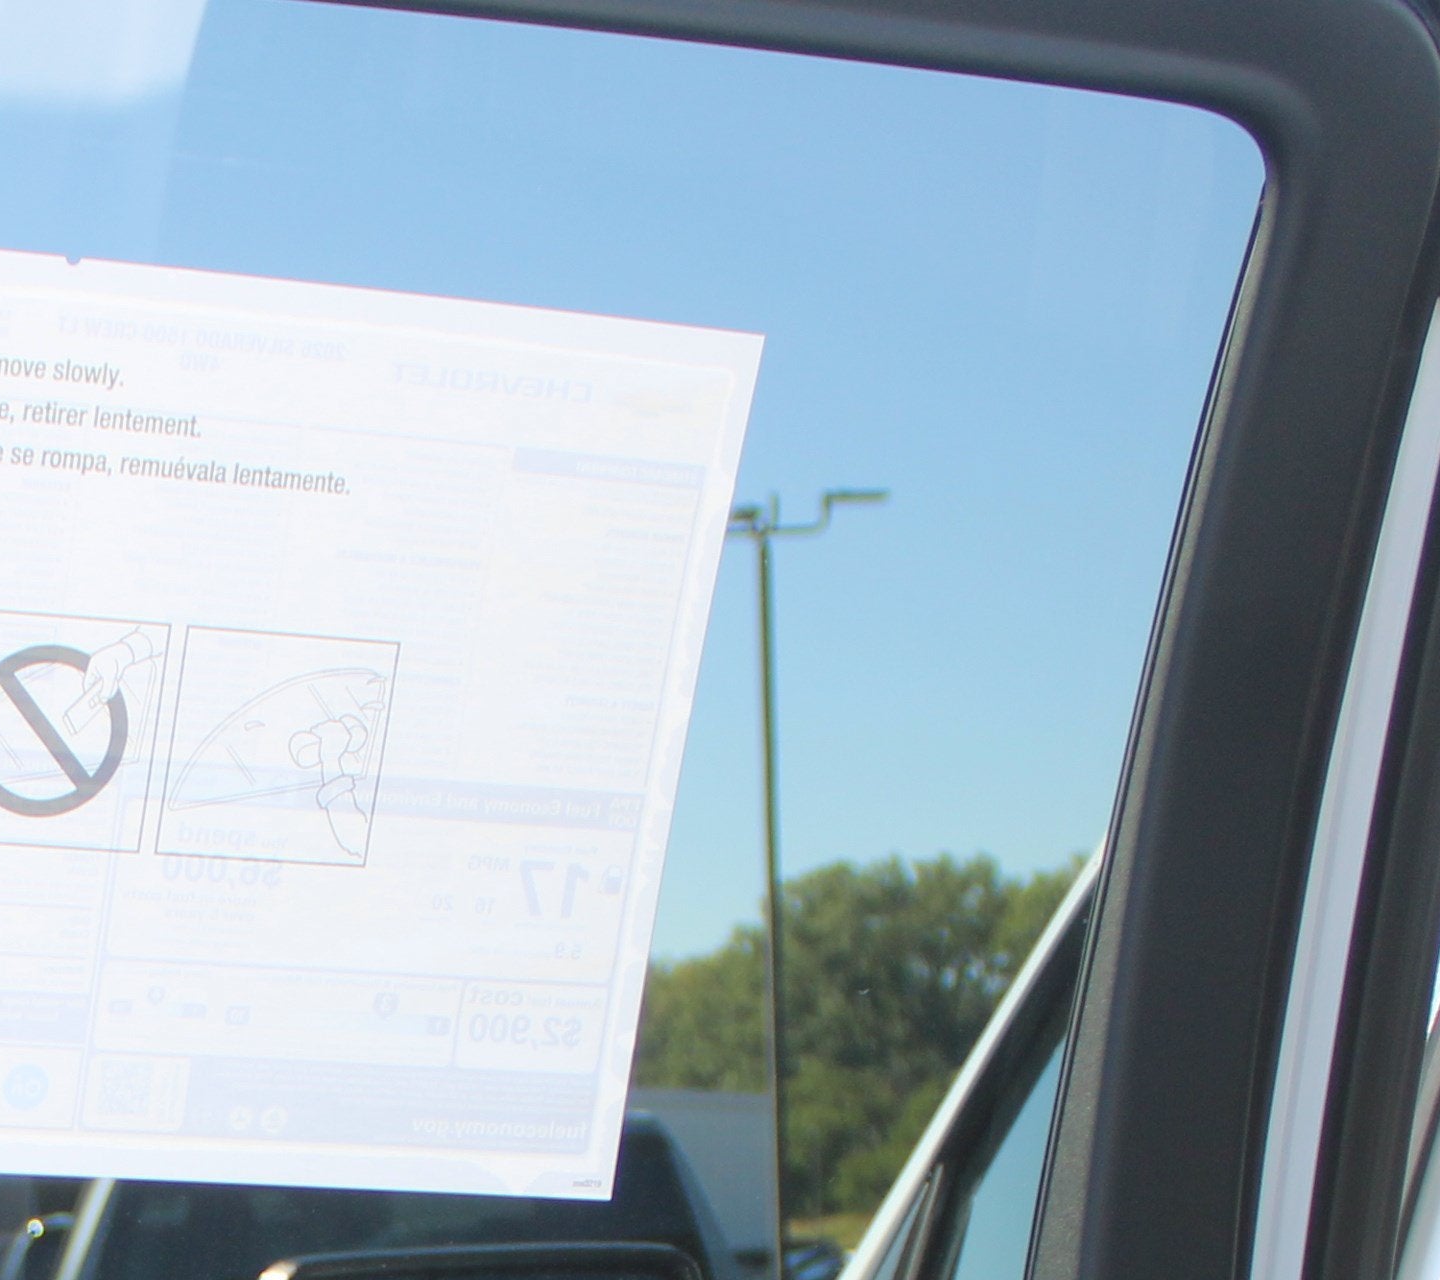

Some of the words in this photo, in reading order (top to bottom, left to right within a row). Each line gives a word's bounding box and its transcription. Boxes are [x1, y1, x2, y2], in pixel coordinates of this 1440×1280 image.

[53, 359, 125, 390] slowly.
[23, 401, 88, 427] retirer
[94, 405, 202, 438] lentement.
[11, 447, 34, 466] se
[41, 449, 112, 476] rompa,
[120, 455, 227, 483] remuévala
[233, 462, 351, 496] lentamente.
